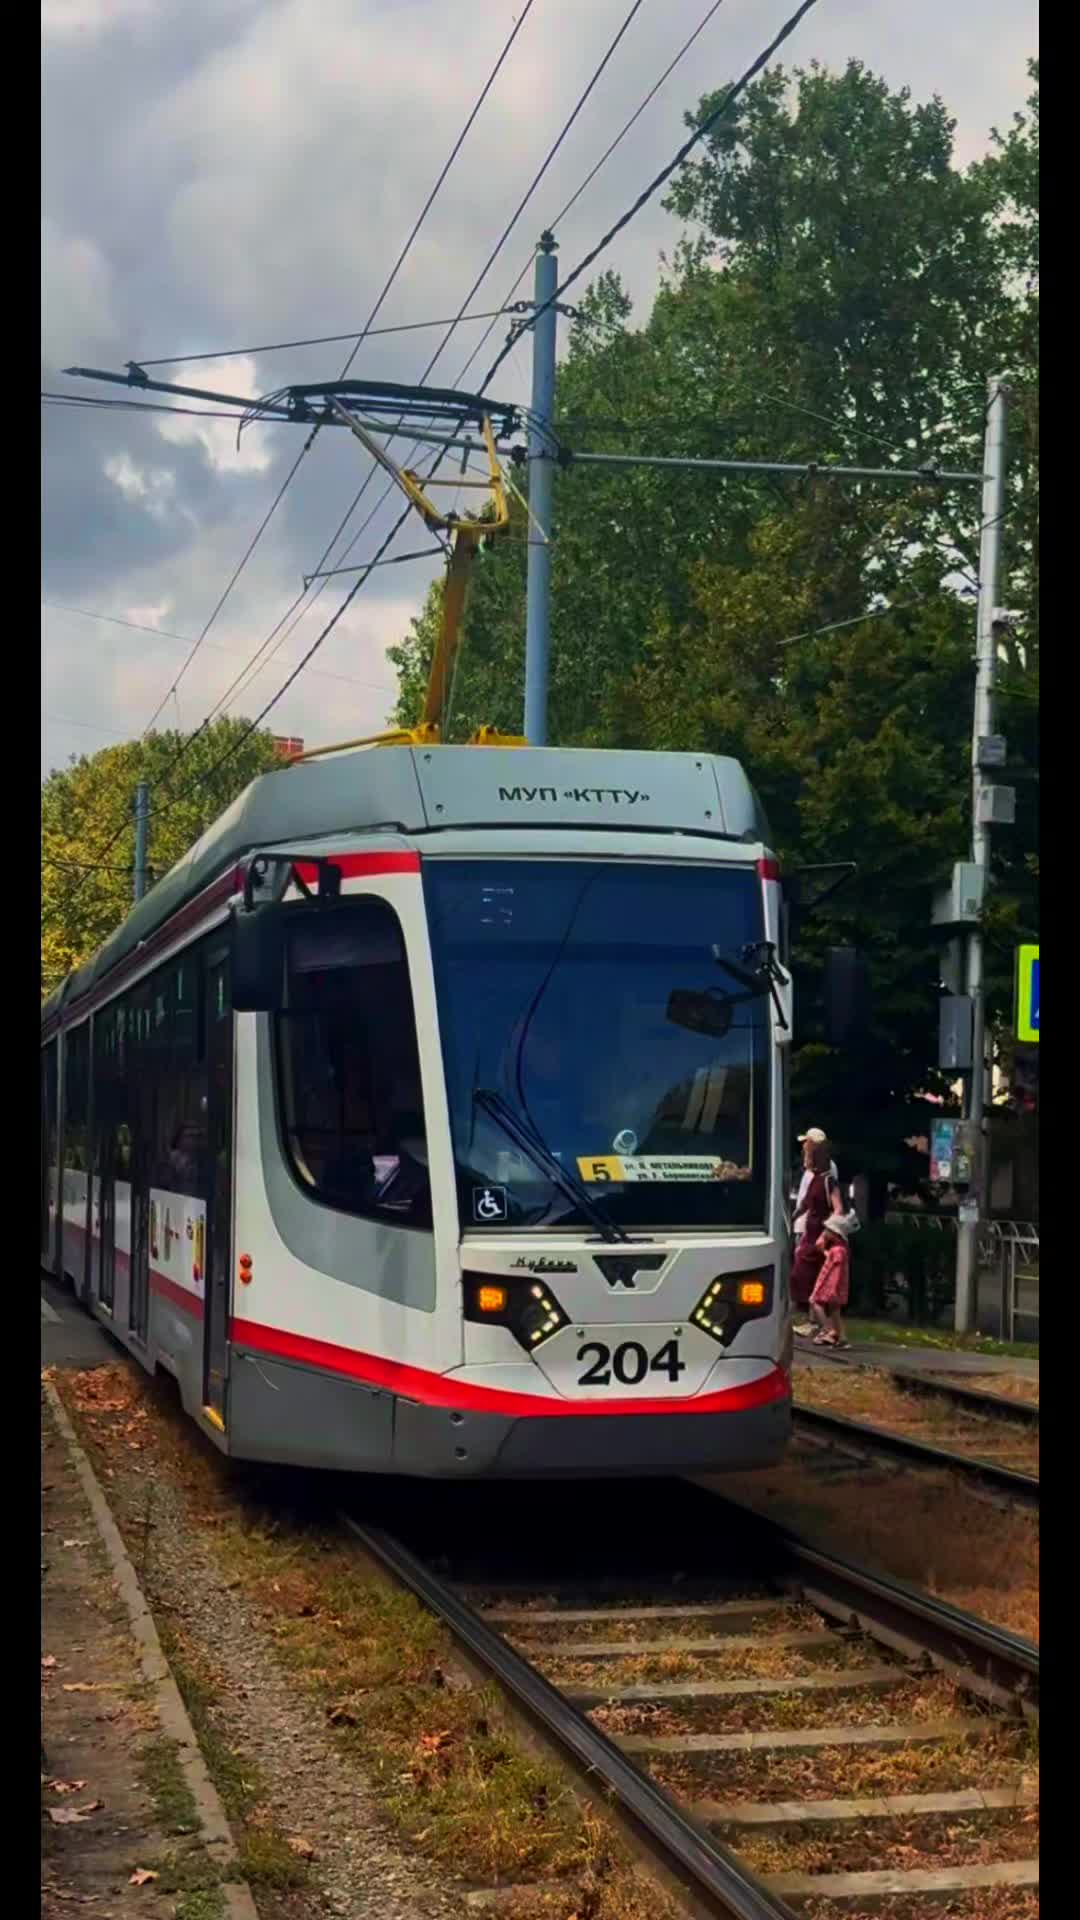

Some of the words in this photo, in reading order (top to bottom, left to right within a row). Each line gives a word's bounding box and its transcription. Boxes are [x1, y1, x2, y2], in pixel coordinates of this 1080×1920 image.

[498, 787, 557, 802] МУП
[564, 787, 650, 804] «КТТУ»
[592, 1163, 611, 1181] 5
[576, 1340, 686, 1385] 204
